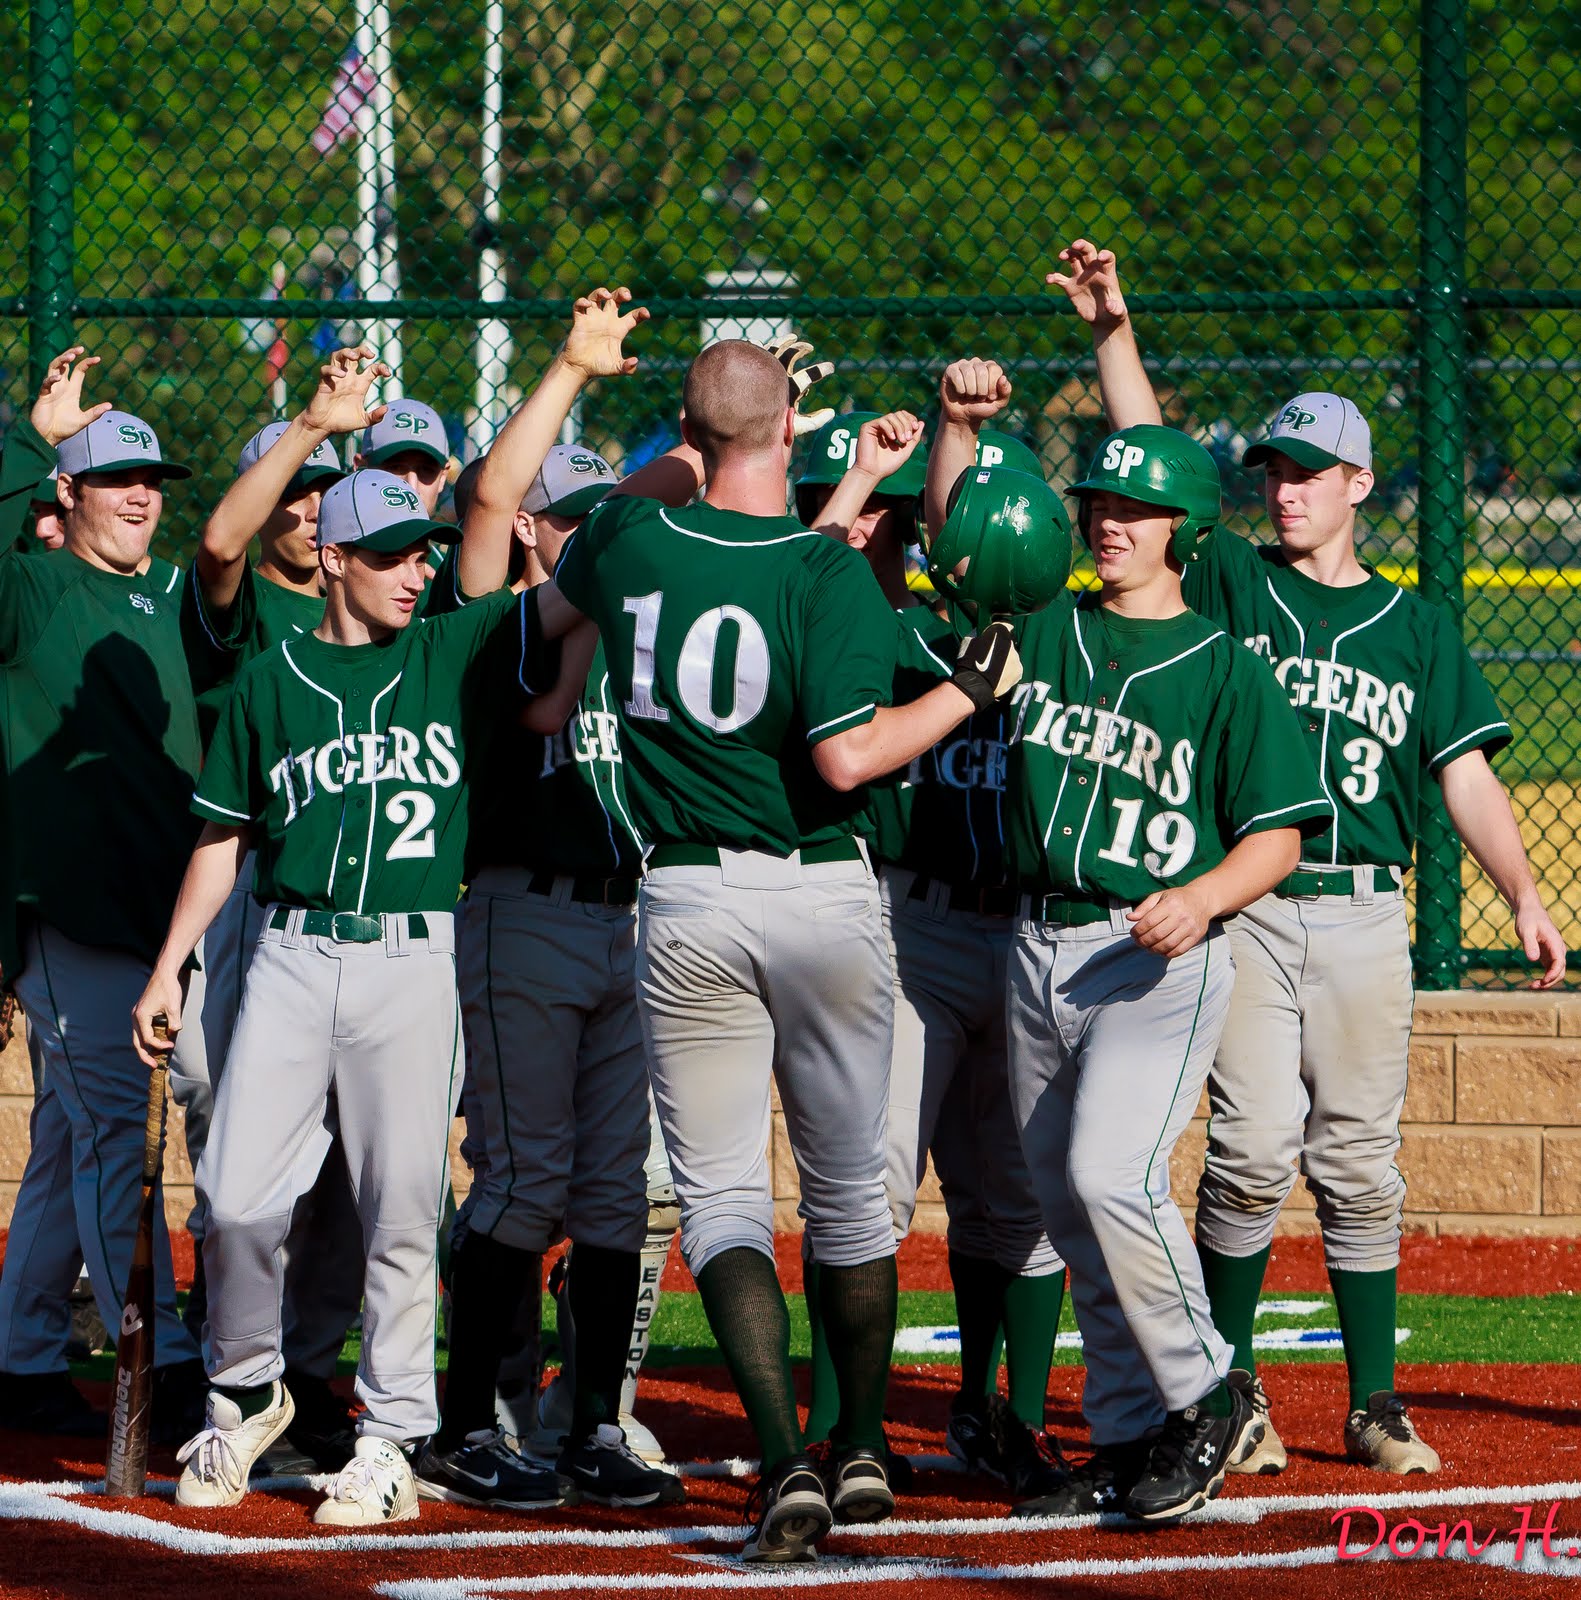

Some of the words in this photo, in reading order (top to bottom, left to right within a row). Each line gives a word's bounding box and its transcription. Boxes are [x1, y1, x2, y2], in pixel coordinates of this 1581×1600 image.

[116, 423, 153, 451] SP
[393, 411, 430, 437] SP
[827, 428, 859, 470] S
[1279, 403, 1319, 433] SP
[974, 441, 1004, 468] P
[1102, 438, 1145, 479] SP
[380, 484, 420, 513] SP
[622, 590, 771, 733] 10
[1243, 633, 1416, 748] GERS
[268, 721, 461, 827] TIGERS
[1008, 680, 1195, 806] TIGERS
[1341, 736, 1384, 805] 3
[385, 790, 436, 861] 2
[1097, 797, 1197, 878] 19
[623, 1266, 659, 1380] EASTON
